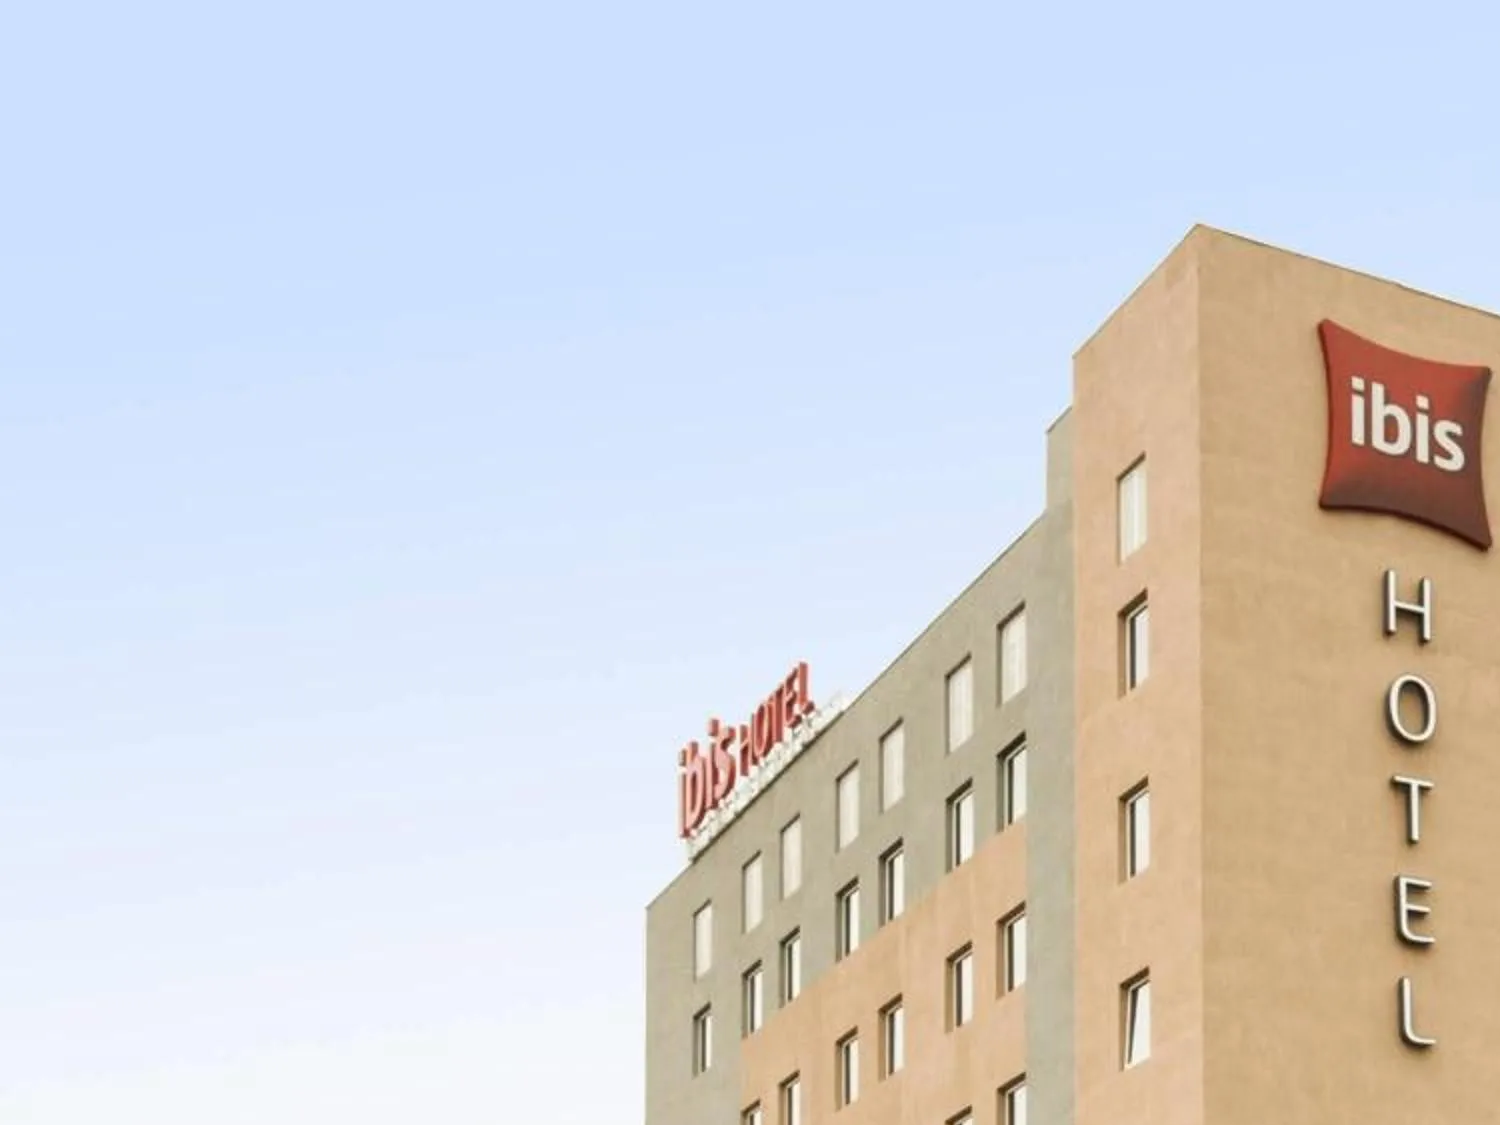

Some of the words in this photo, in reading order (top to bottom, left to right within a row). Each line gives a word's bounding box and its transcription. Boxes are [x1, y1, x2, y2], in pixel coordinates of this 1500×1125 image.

[1351, 375, 1465, 472] ibis
[680, 718, 737, 838] ibis
[740, 661, 815, 777] HOTEL
[1383, 568, 1437, 1046] HOTEL
